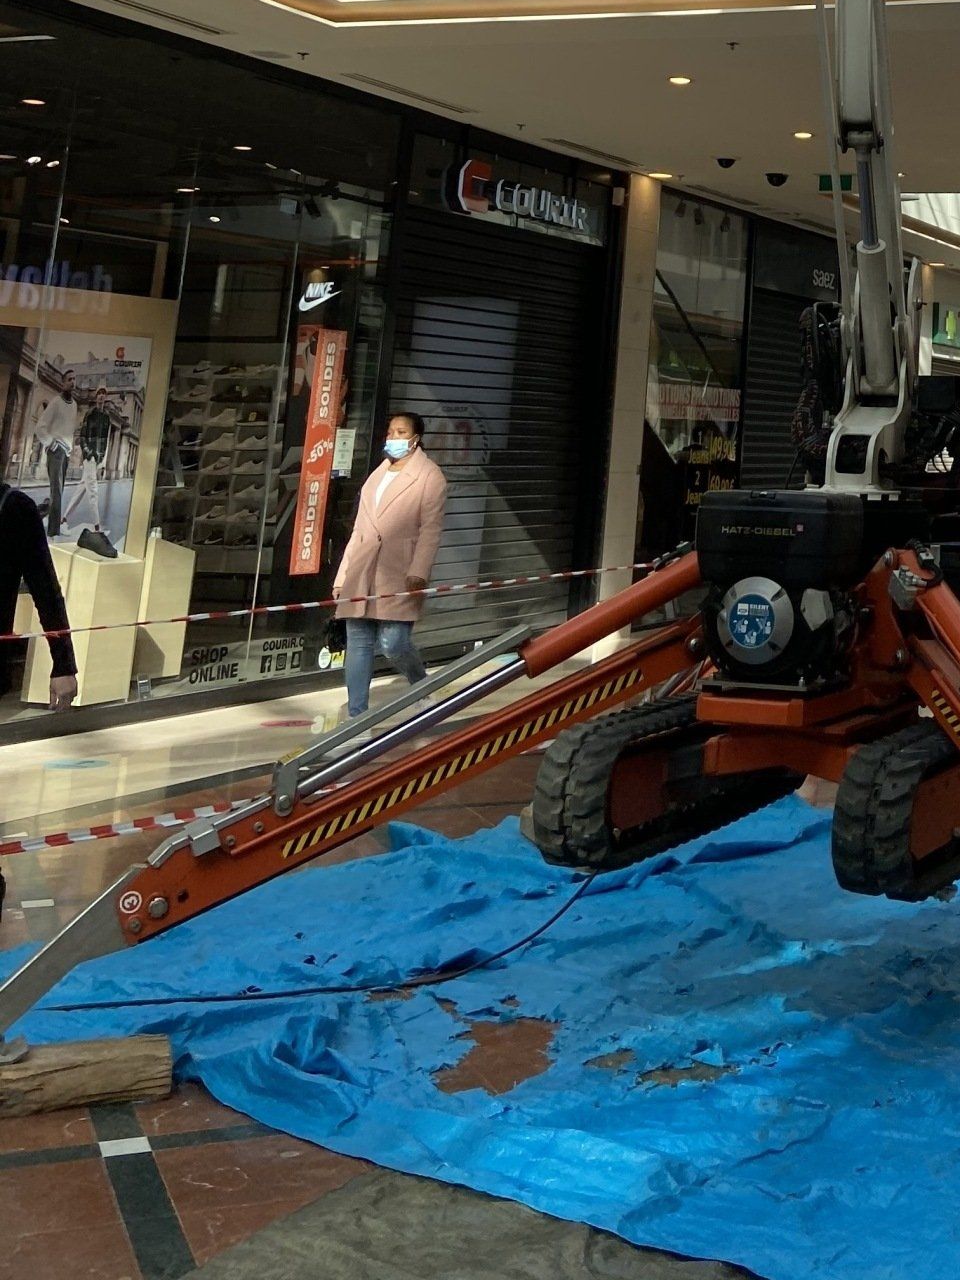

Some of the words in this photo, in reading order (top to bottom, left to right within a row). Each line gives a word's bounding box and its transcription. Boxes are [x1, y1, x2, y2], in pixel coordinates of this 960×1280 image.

[496, 179, 588, 231] COURIR
[305, 282, 335, 298] NIKE
[813, 269, 835, 289] saez
[320, 342, 336, 418] SOLDES
[306, 440, 334, 464] -50%
[301, 480, 320, 560] SOLDES
[721, 526, 797, 536] HATZ-DIESEL
[191, 646, 229, 666] SHOP
[188, 662, 239, 684] ONLINE
